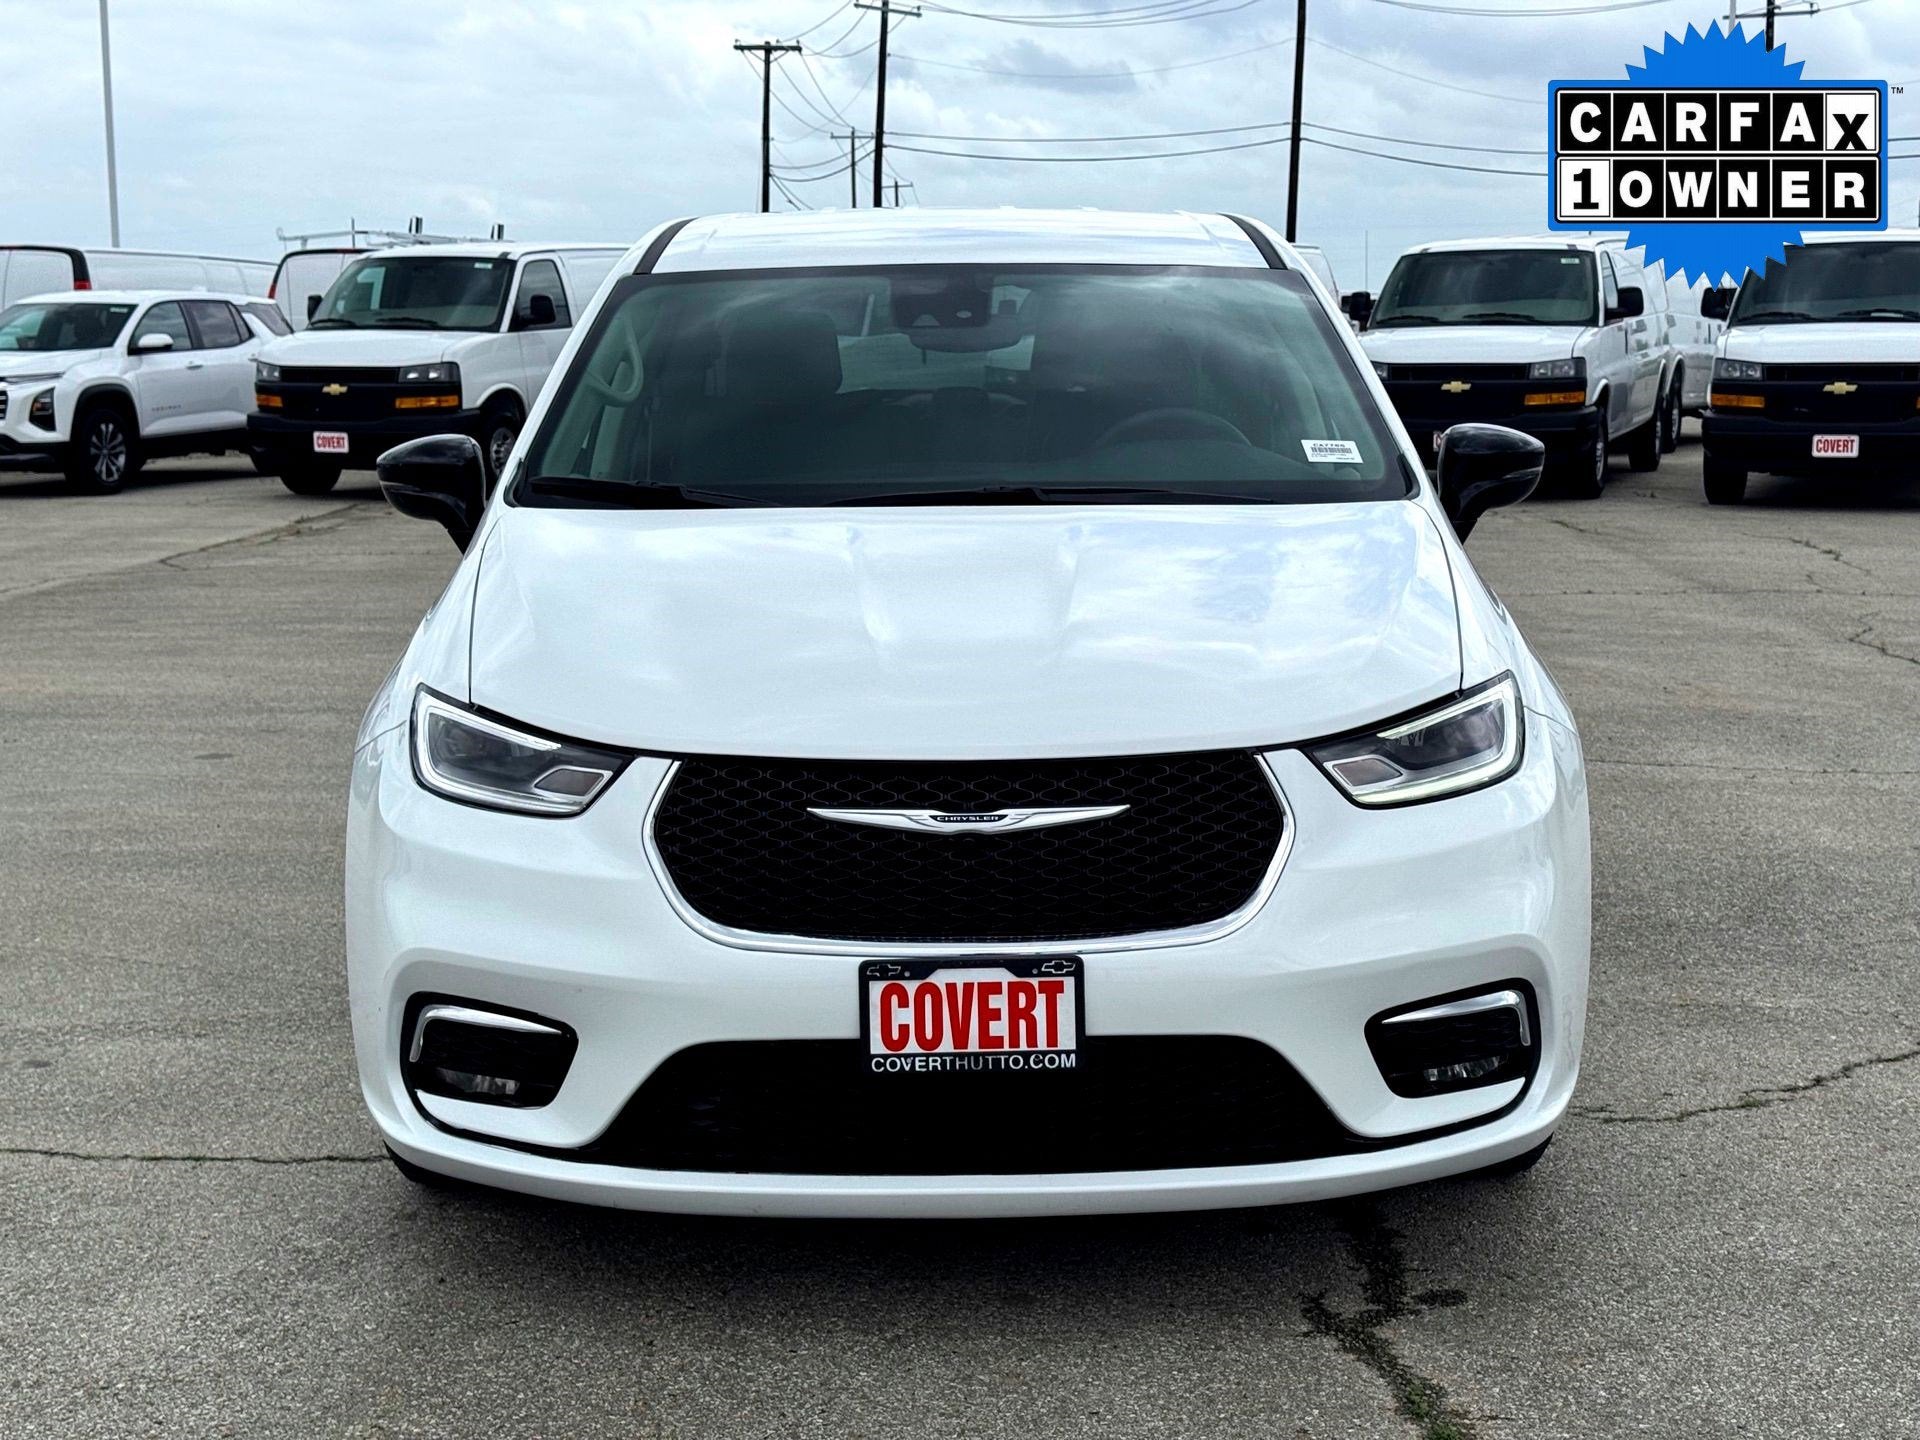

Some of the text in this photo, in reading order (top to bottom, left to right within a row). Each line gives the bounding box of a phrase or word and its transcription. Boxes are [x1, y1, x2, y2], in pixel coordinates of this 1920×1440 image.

[316, 435, 346, 449] COVERT
[1816, 438, 1855, 453] COVERT
[880, 980, 1064, 1052] COVERT
[870, 1053, 1077, 1073] COVERTHUTTO.COM
